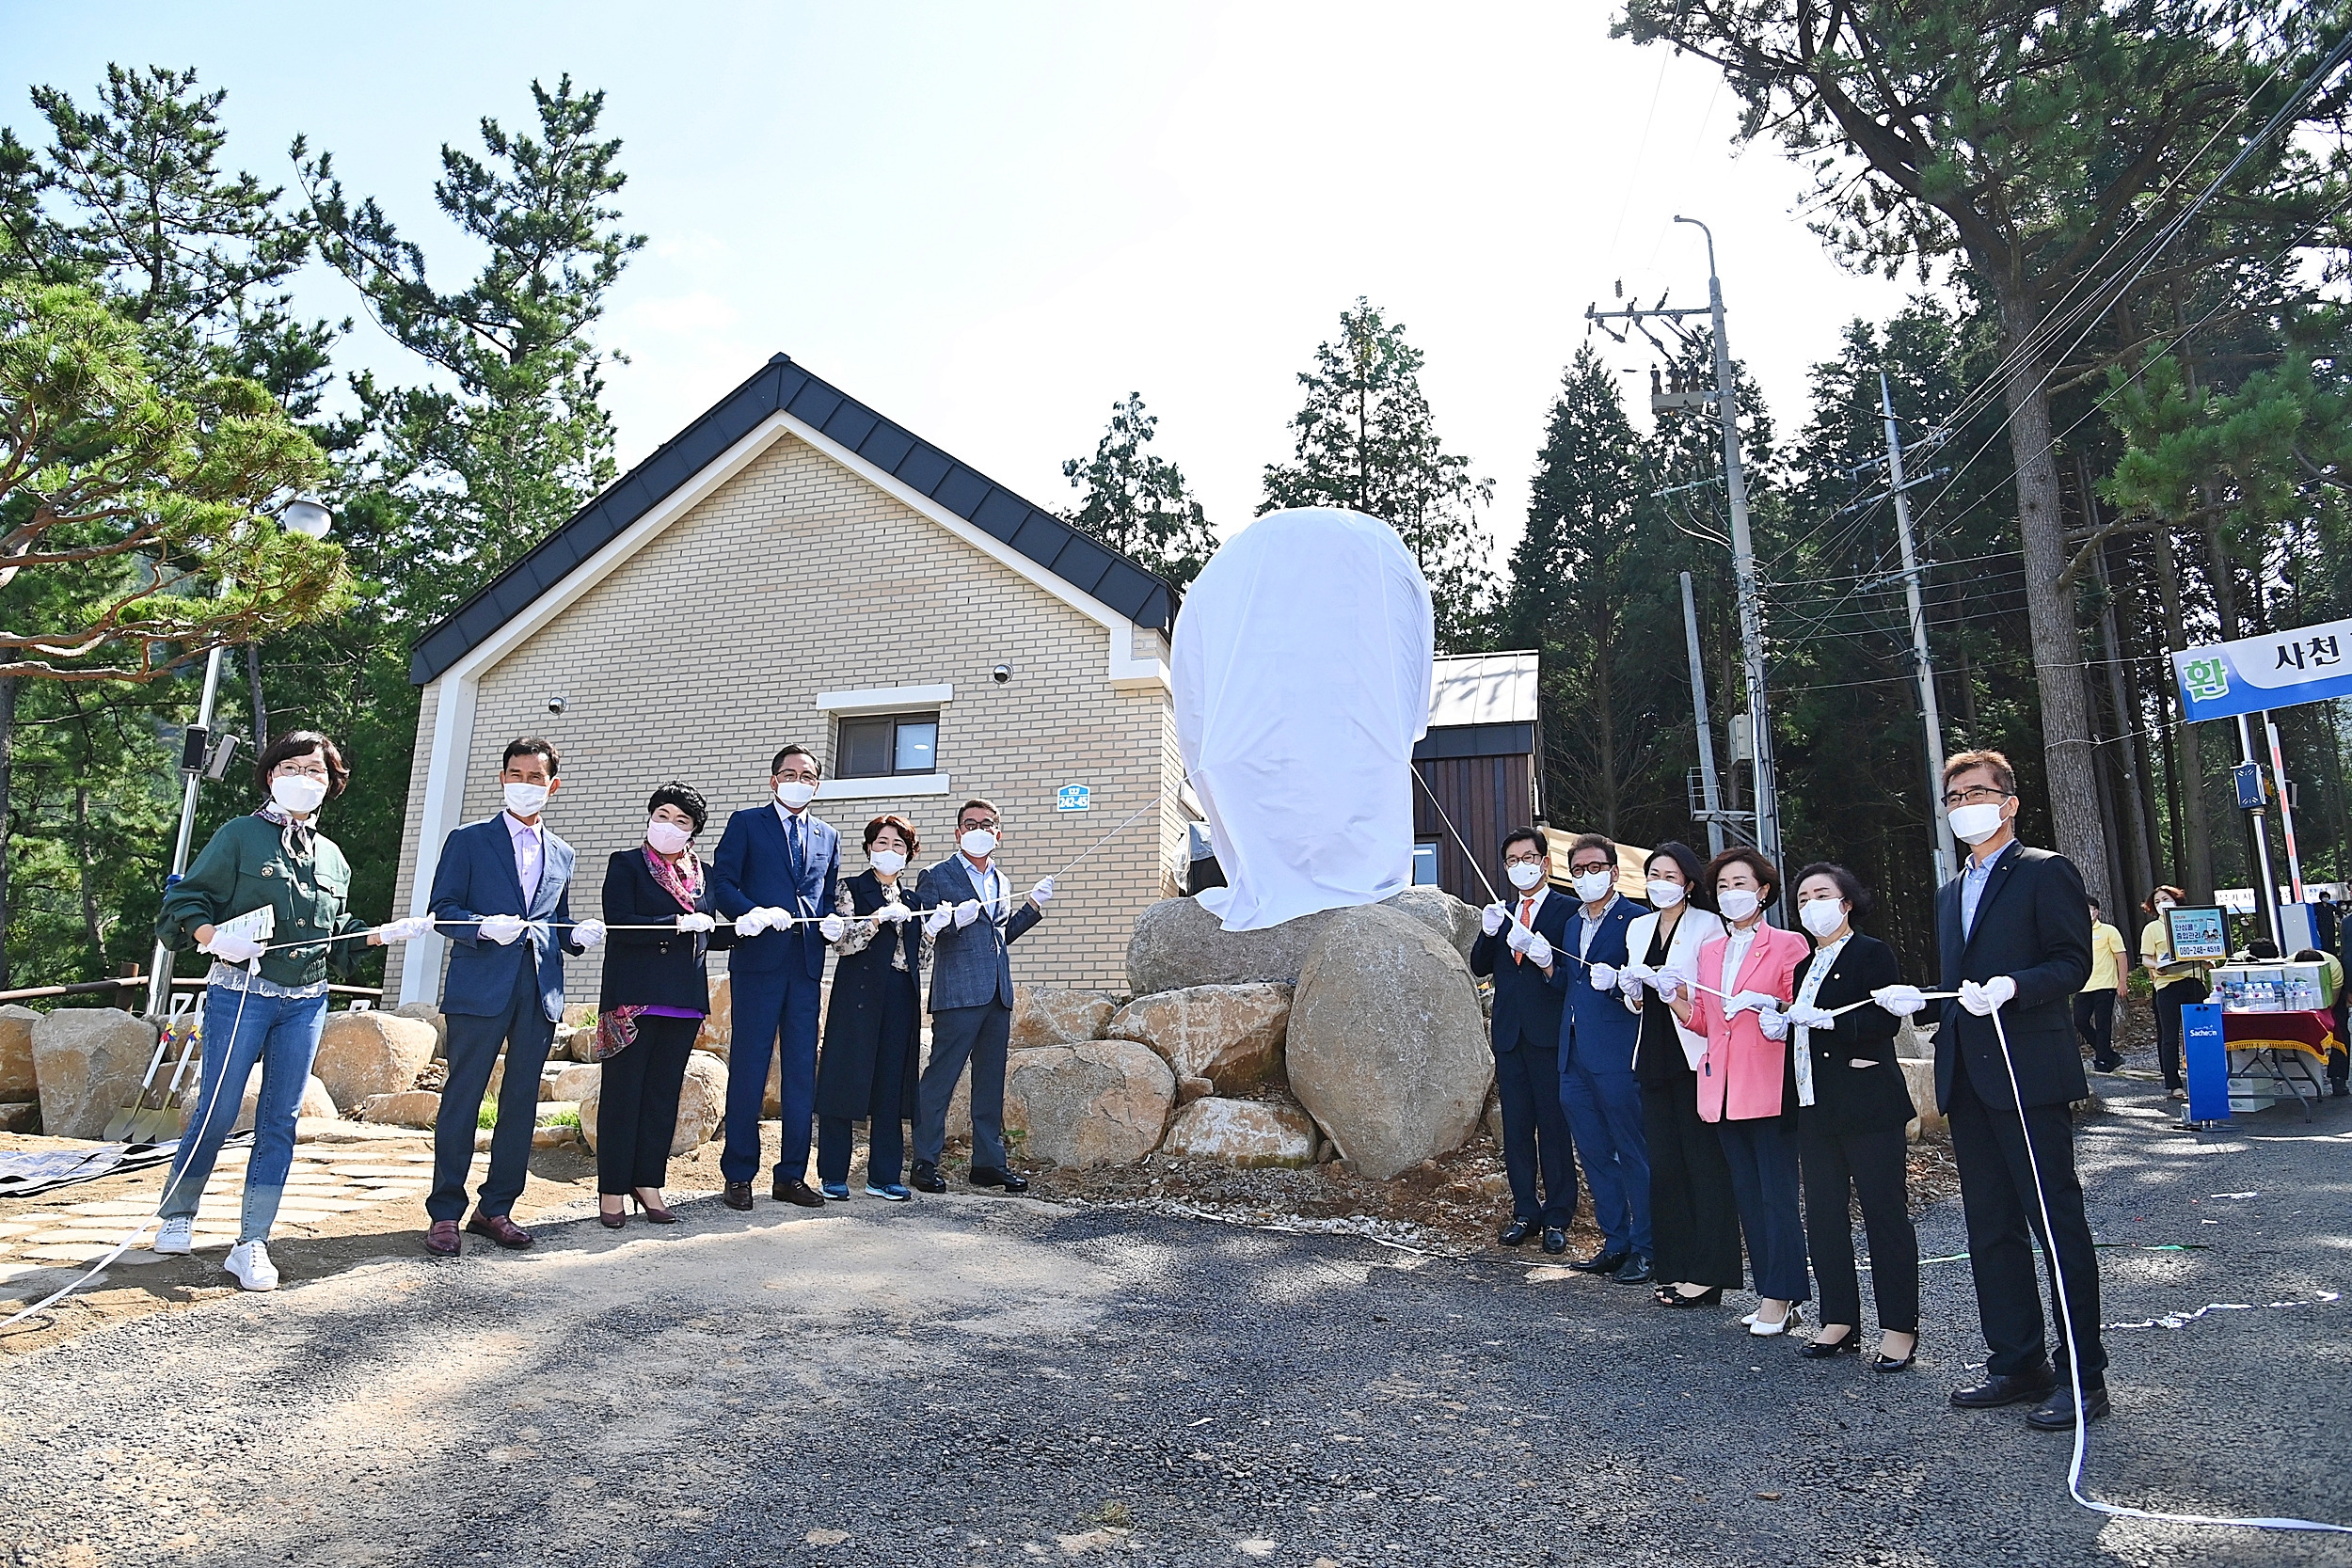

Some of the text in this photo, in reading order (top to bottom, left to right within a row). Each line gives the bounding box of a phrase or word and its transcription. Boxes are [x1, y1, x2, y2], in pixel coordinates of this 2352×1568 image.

[2183, 635, 2342, 701] 환 사천
[1058, 796, 1088, 808] 242-45
[2179, 945, 2221, 956] 080-248-4518
